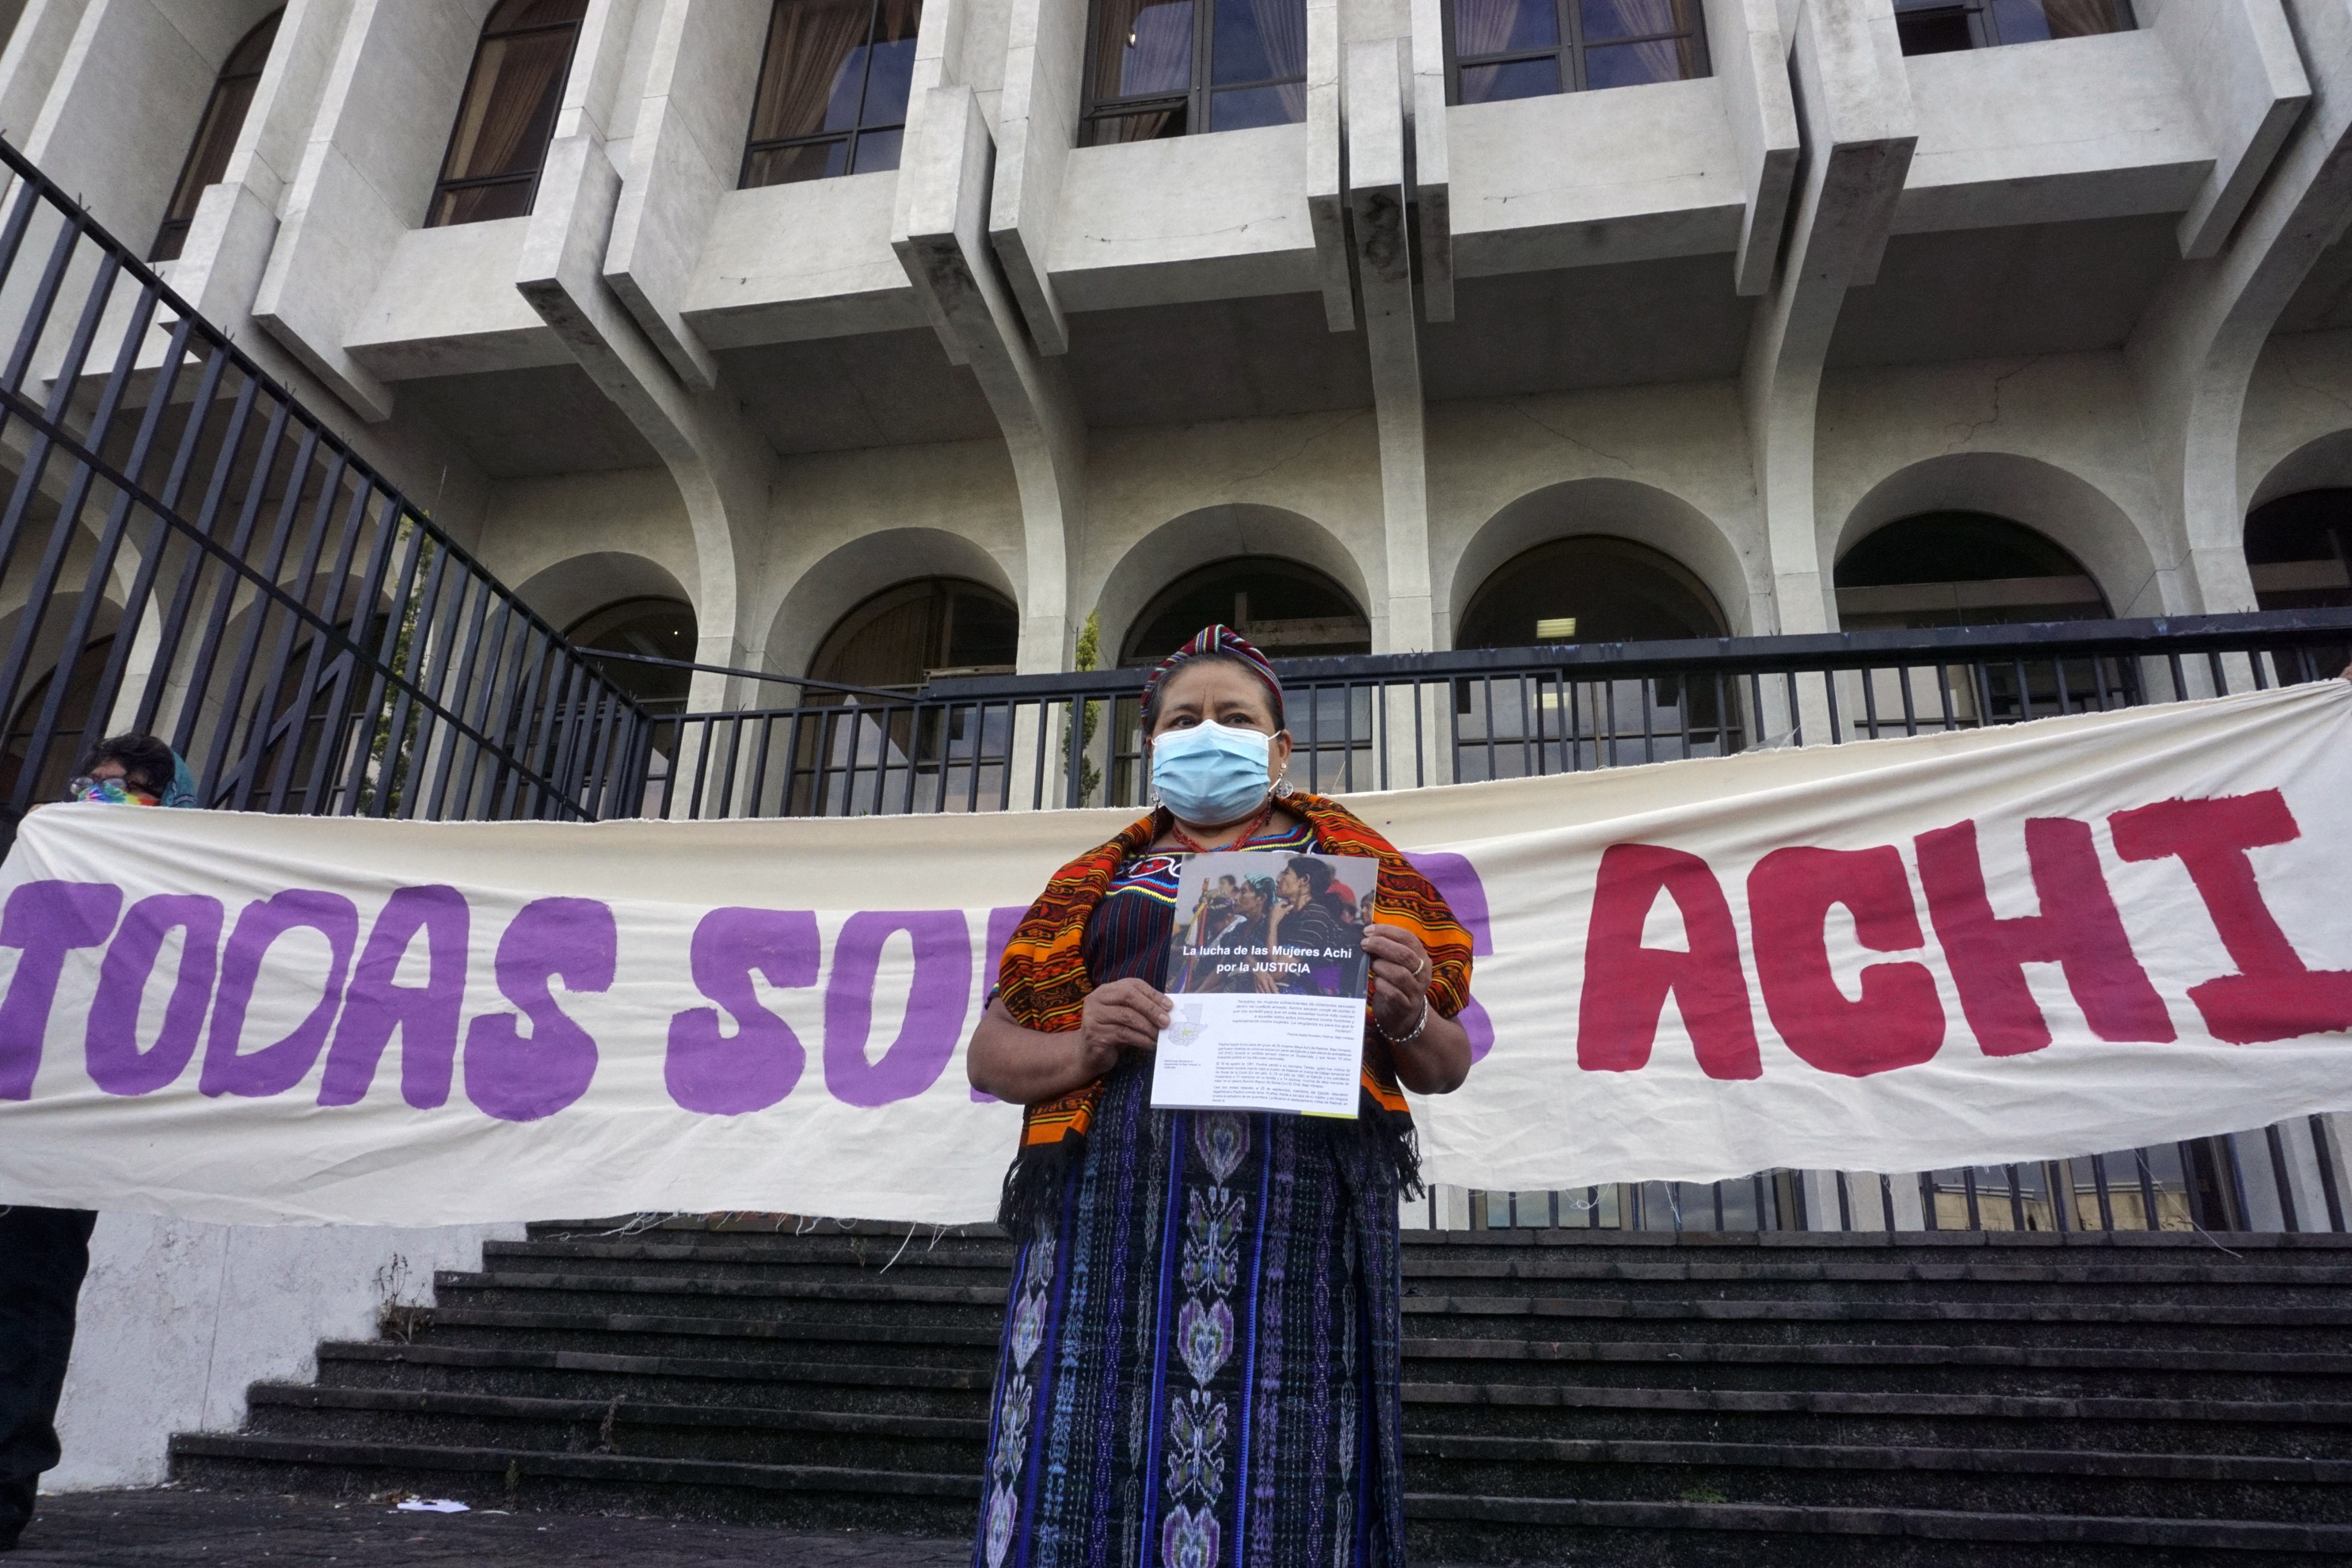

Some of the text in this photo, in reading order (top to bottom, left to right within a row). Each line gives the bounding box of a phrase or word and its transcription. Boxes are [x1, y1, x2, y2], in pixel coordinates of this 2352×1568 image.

[0, 879, 617, 1122] TODAS
[1576, 786, 2352, 1080] ACHI
[1182, 945, 1352, 958] La lucha de las Mujeres Achi
[1216, 961, 1311, 974] por la JUSTICIA
